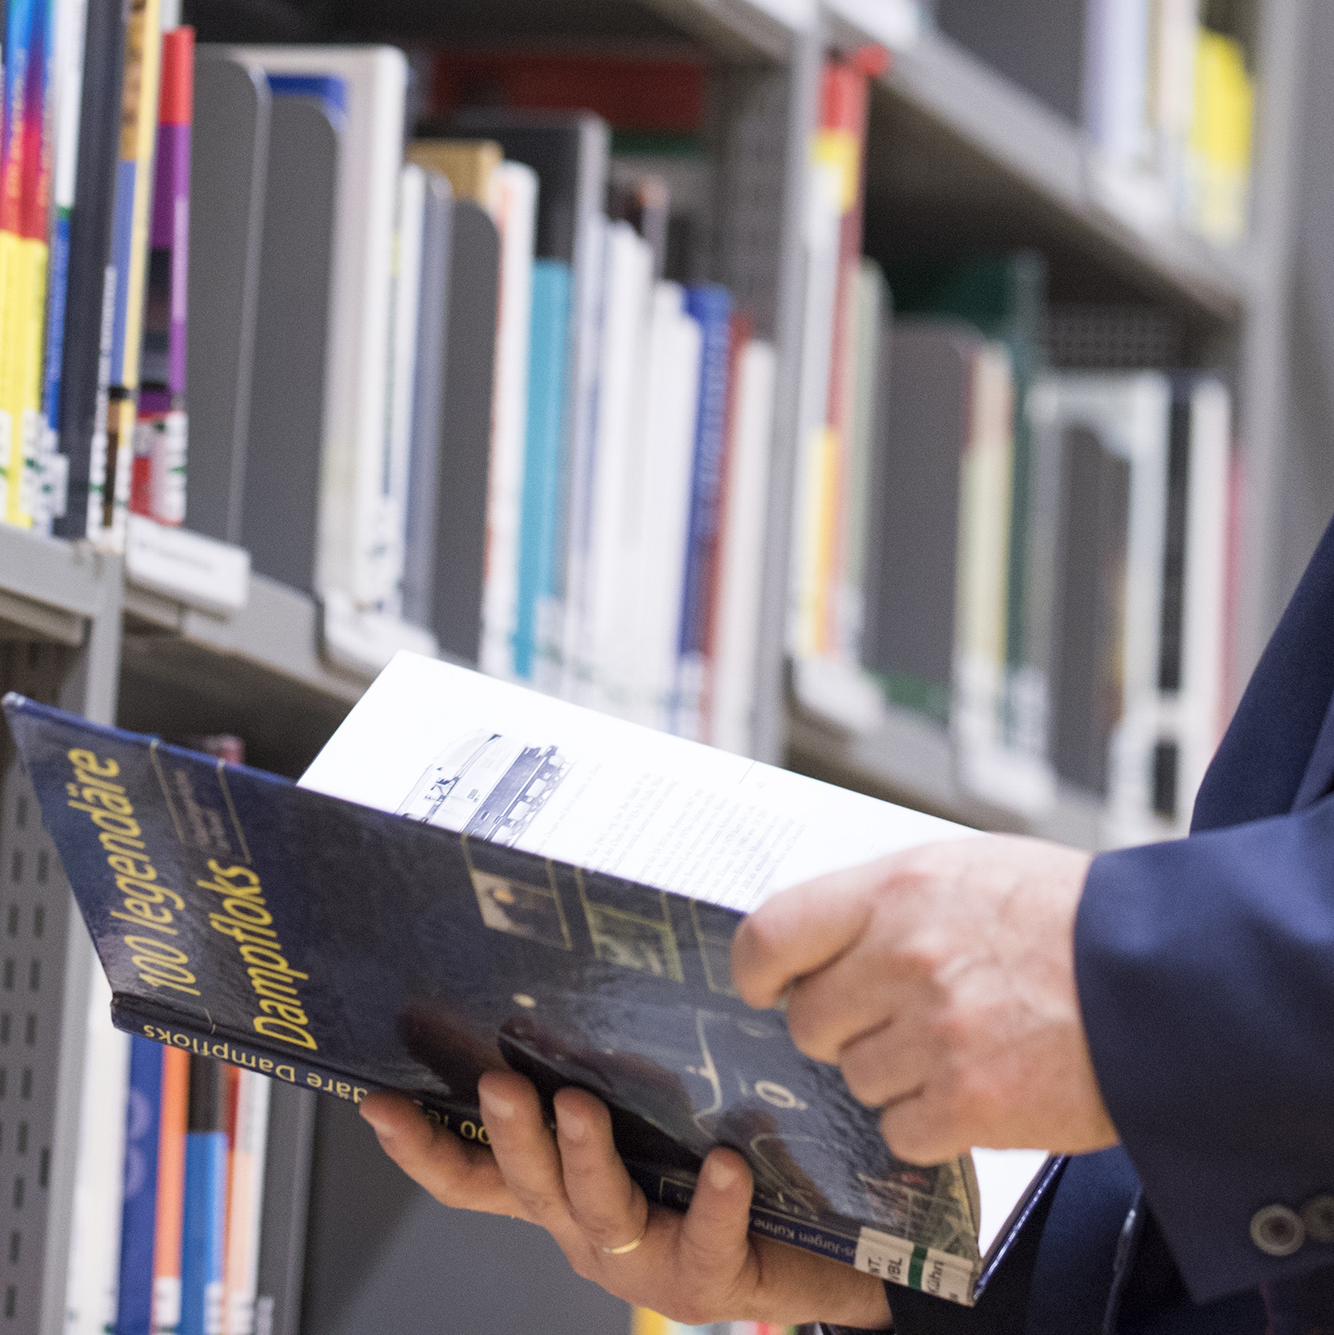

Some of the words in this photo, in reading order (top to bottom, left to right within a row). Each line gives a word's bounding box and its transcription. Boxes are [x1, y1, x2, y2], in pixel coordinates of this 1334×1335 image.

[65, 748, 186, 935] legendäre
[123, 934, 201, 997] 100
[196, 859, 319, 1051] Dampfloks
[142, 1024, 296, 1082] Dampfloks
